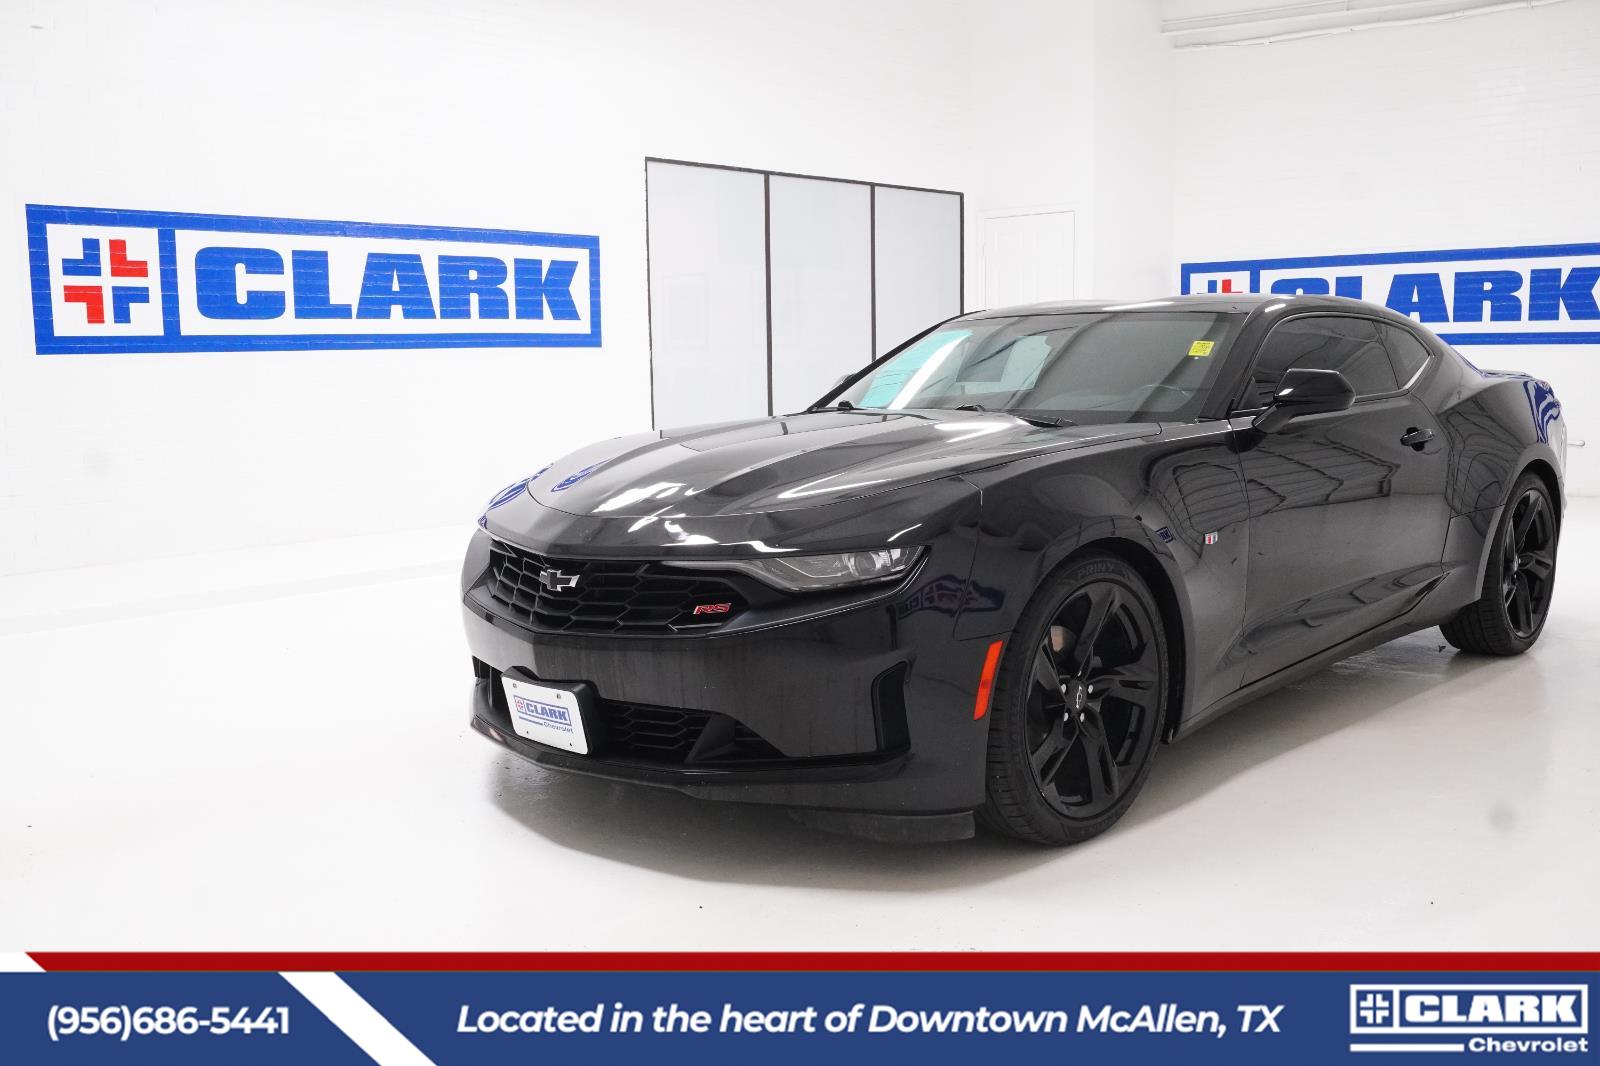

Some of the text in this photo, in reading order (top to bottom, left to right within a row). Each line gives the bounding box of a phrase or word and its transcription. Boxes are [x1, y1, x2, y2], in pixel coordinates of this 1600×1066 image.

[195, 246, 582, 320] CLARK
[693, 602, 732, 615] RS
[525, 702, 569, 722] CLARK
